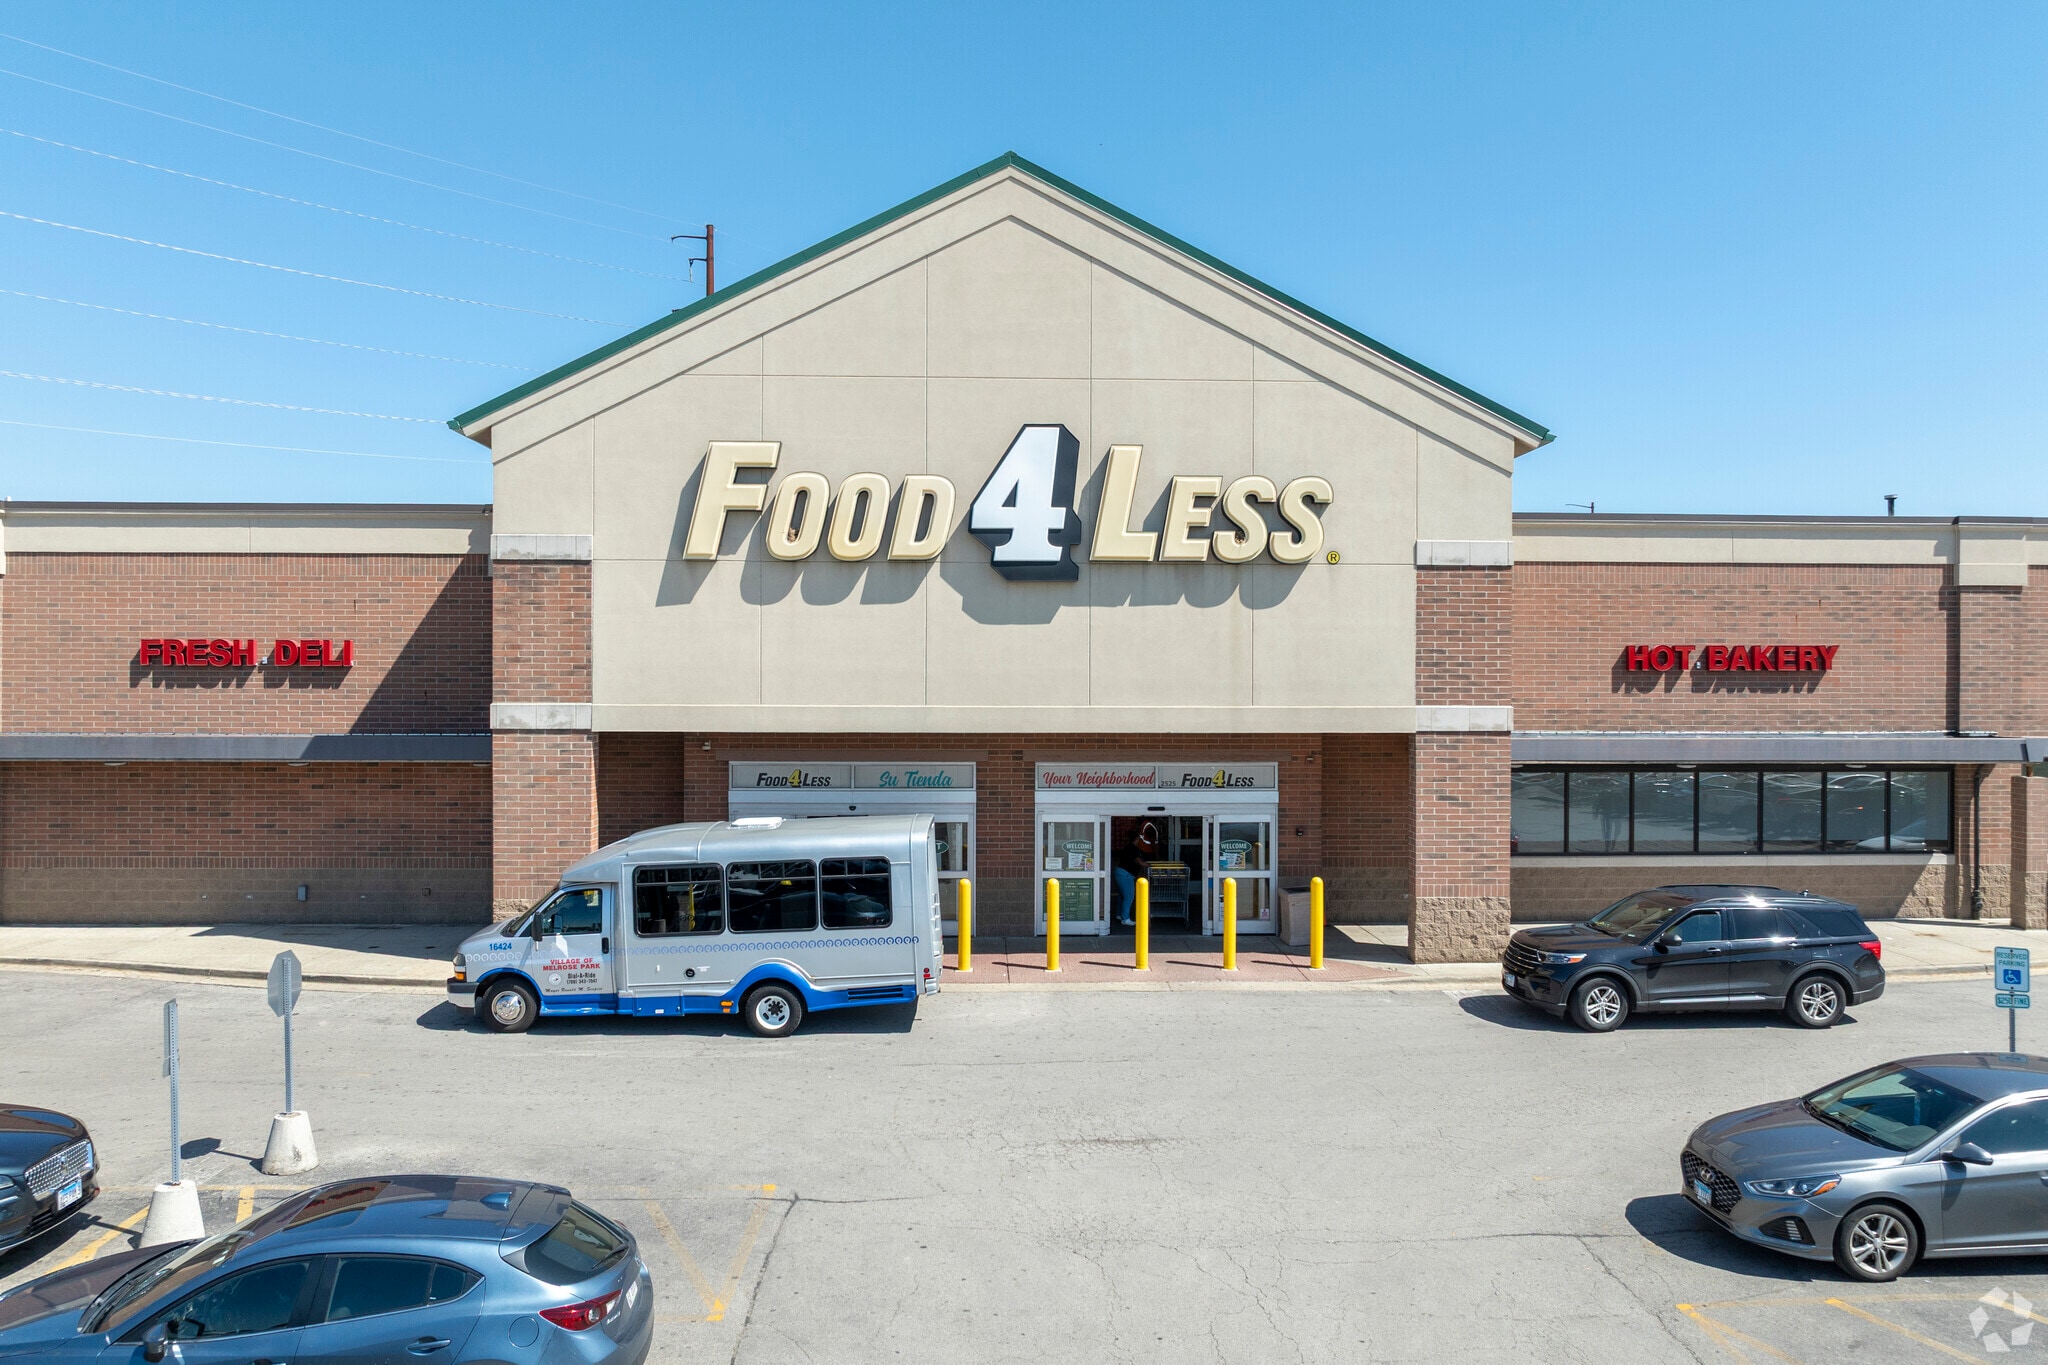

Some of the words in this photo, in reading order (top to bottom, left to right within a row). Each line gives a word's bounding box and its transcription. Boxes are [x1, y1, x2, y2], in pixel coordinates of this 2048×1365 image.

[683, 440, 956, 562] FOOD
[968, 424, 1080, 581] 4
[1089, 444, 1334, 564] LESS
[140, 638, 257, 667] FRESH
[274, 639, 354, 667] DELI
[1625, 644, 1696, 672] HOT
[1706, 644, 1840, 672] BAKERY
[879, 770, 899, 788] Su
[904, 770, 953, 788] Tienda
[1042, 772, 1072, 788] Your
[1076, 771, 1155, 788] Neighborhood
[489, 942, 512, 951] 16424
[1996, 952, 2027, 960] RESERVED
